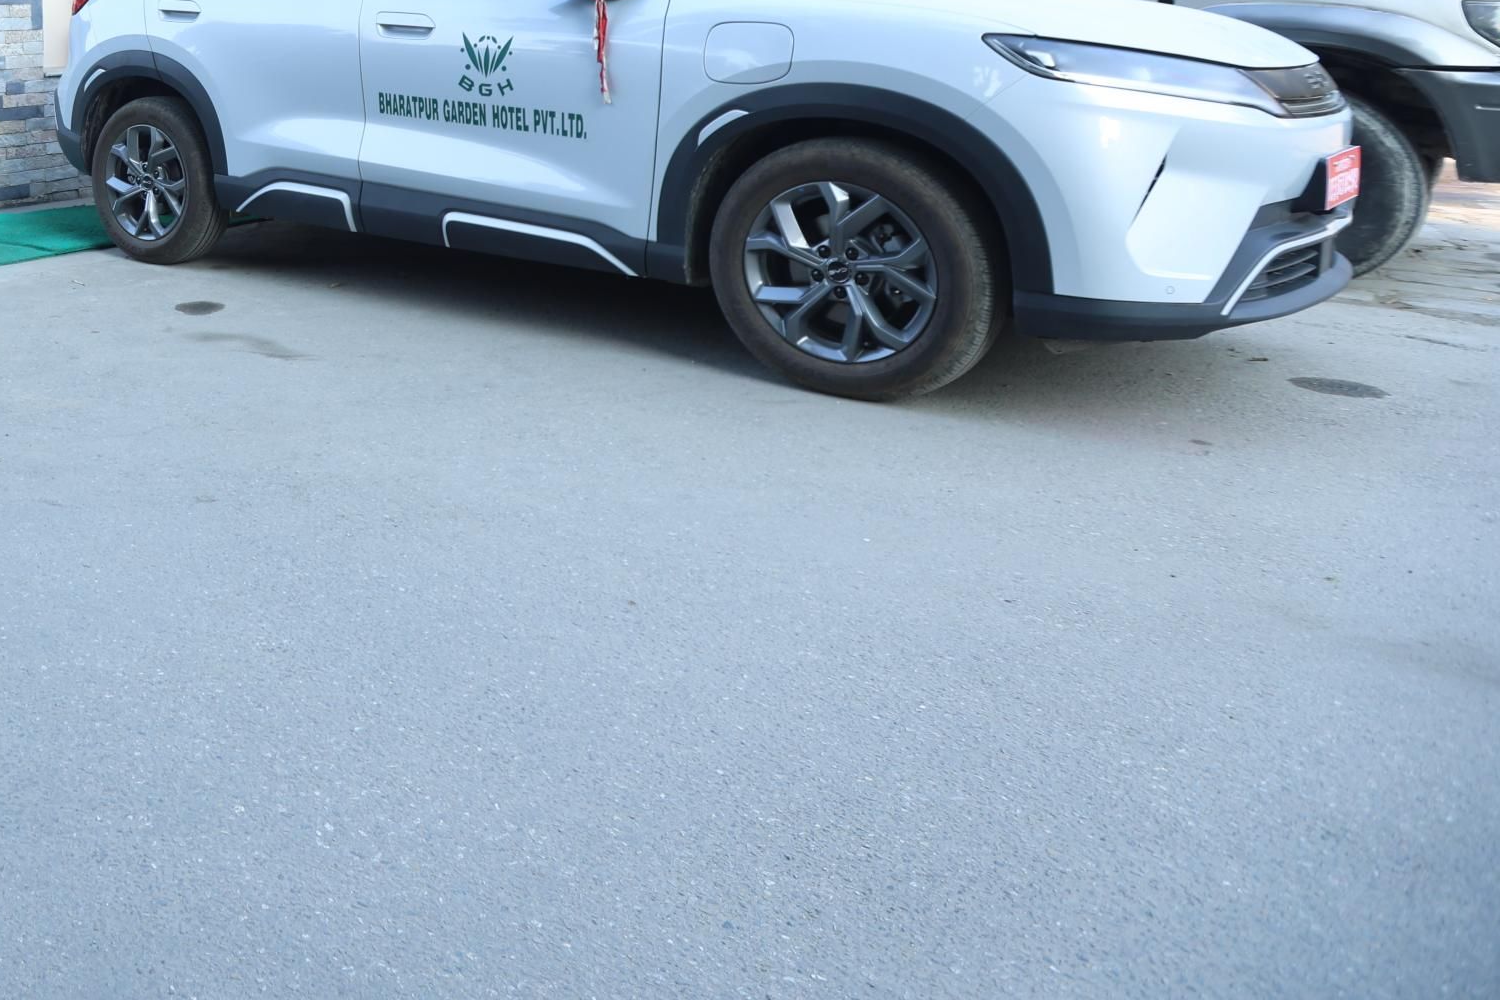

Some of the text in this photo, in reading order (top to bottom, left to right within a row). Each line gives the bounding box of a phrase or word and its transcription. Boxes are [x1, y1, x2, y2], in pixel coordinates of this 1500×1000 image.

[458, 74, 514, 97] BGH
[378, 91, 440, 121] BHARATPUR
[443, 99, 487, 127] GARDEN
[492, 104, 530, 133] HOTEL
